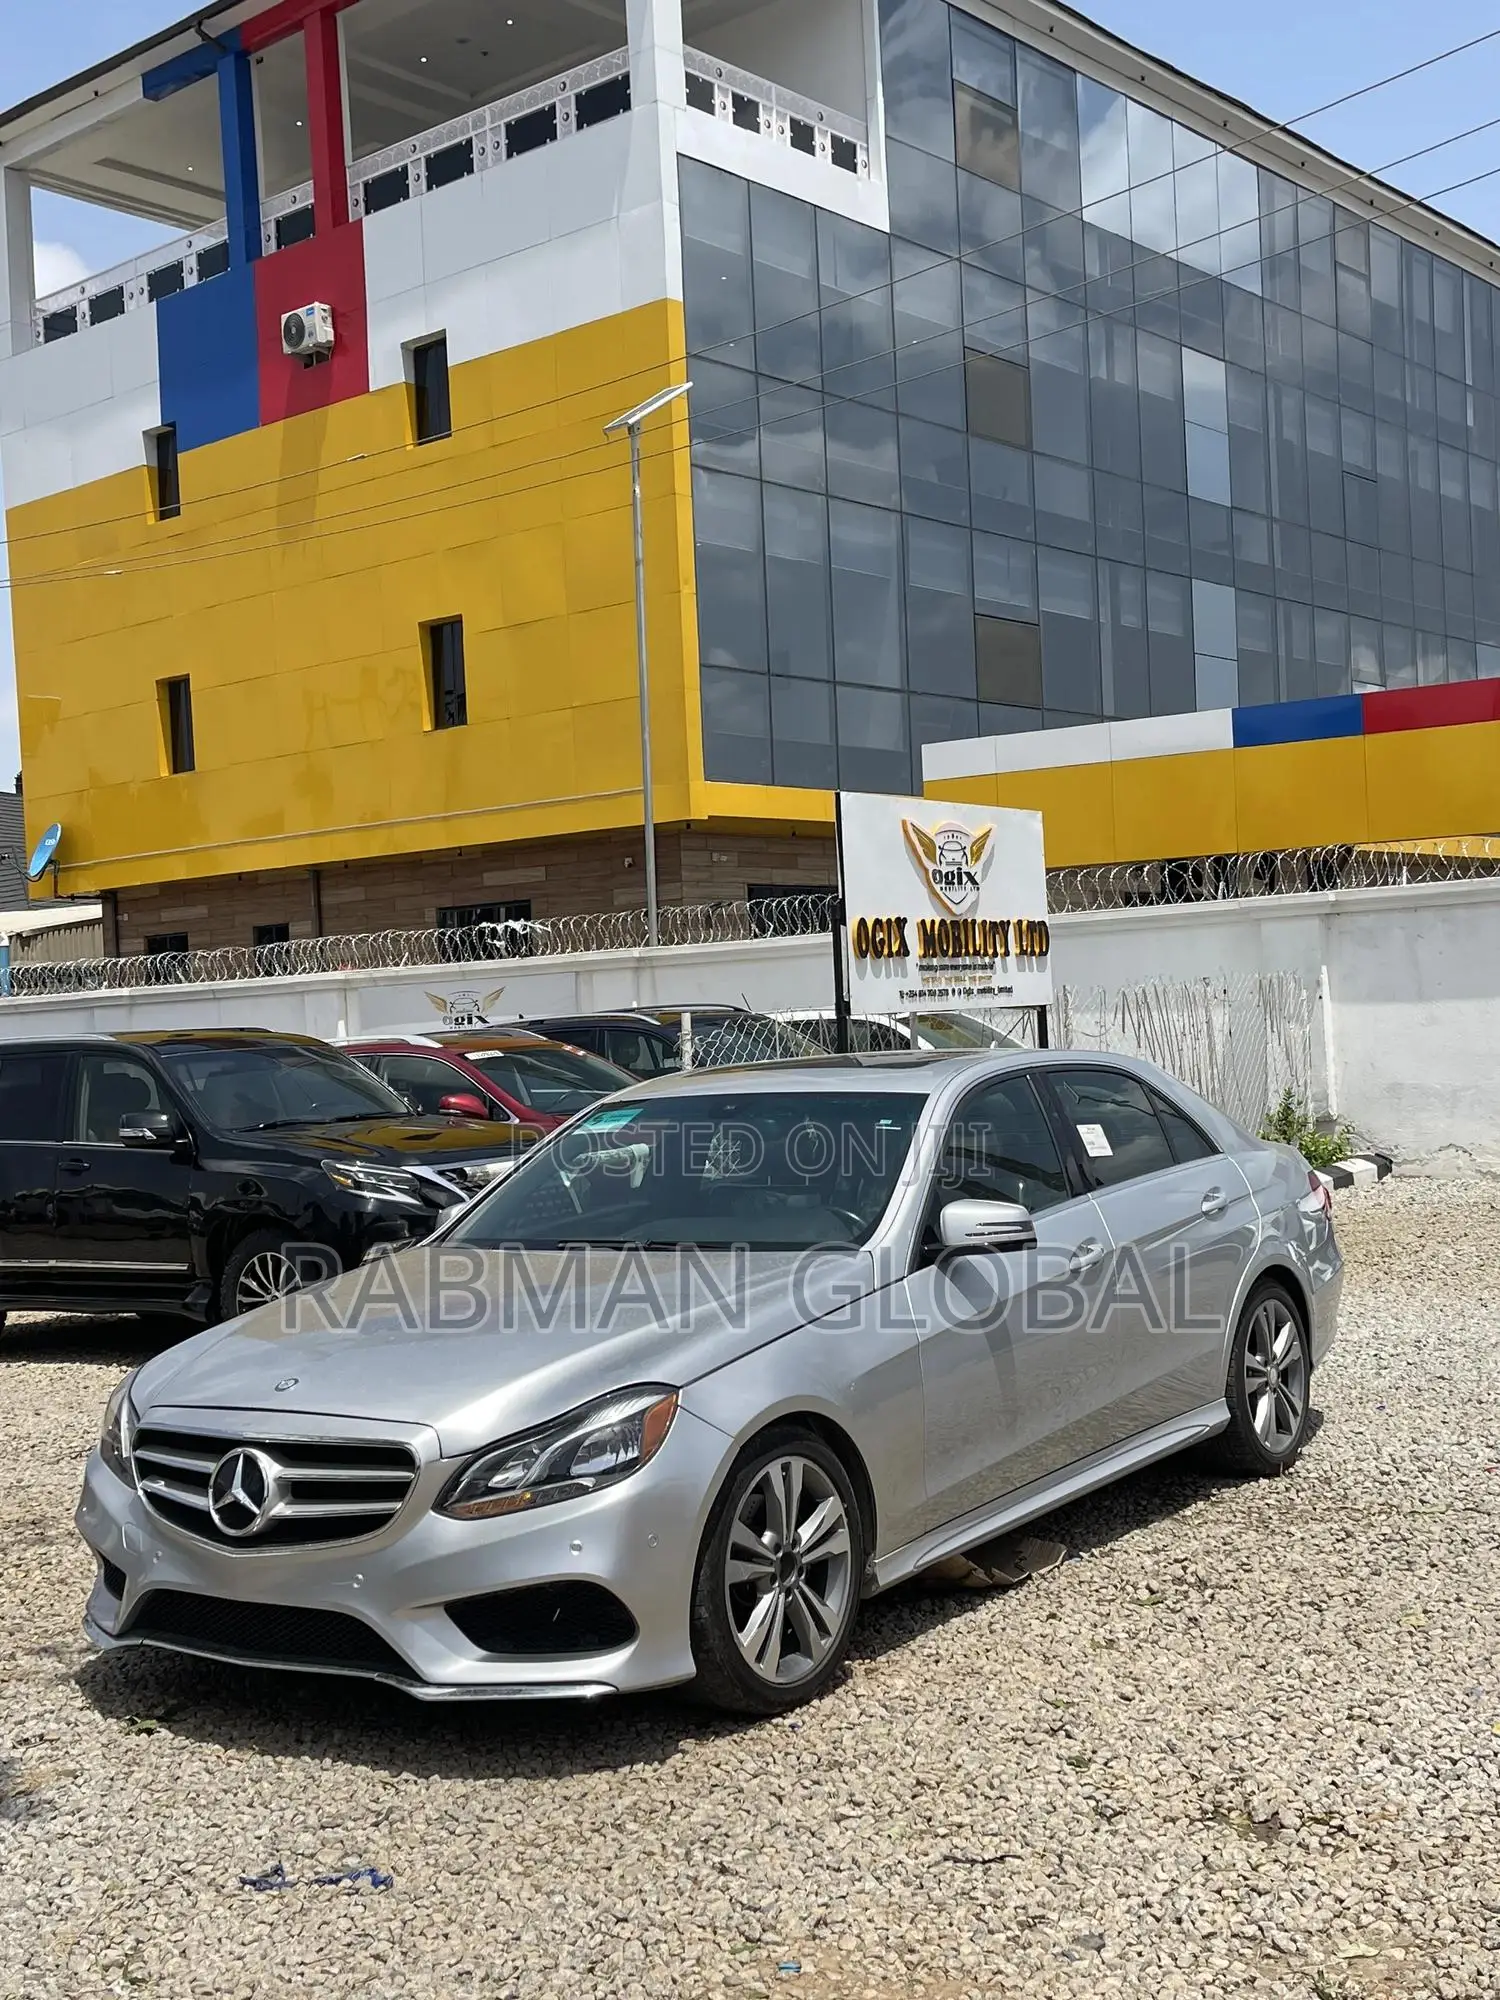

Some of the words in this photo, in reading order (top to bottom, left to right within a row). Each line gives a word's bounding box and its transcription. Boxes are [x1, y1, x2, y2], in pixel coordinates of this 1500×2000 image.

[852, 917, 910, 960] OGIX
[916, 918, 1011, 959] MOBILITY
[1012, 919, 1050, 957] LTD
